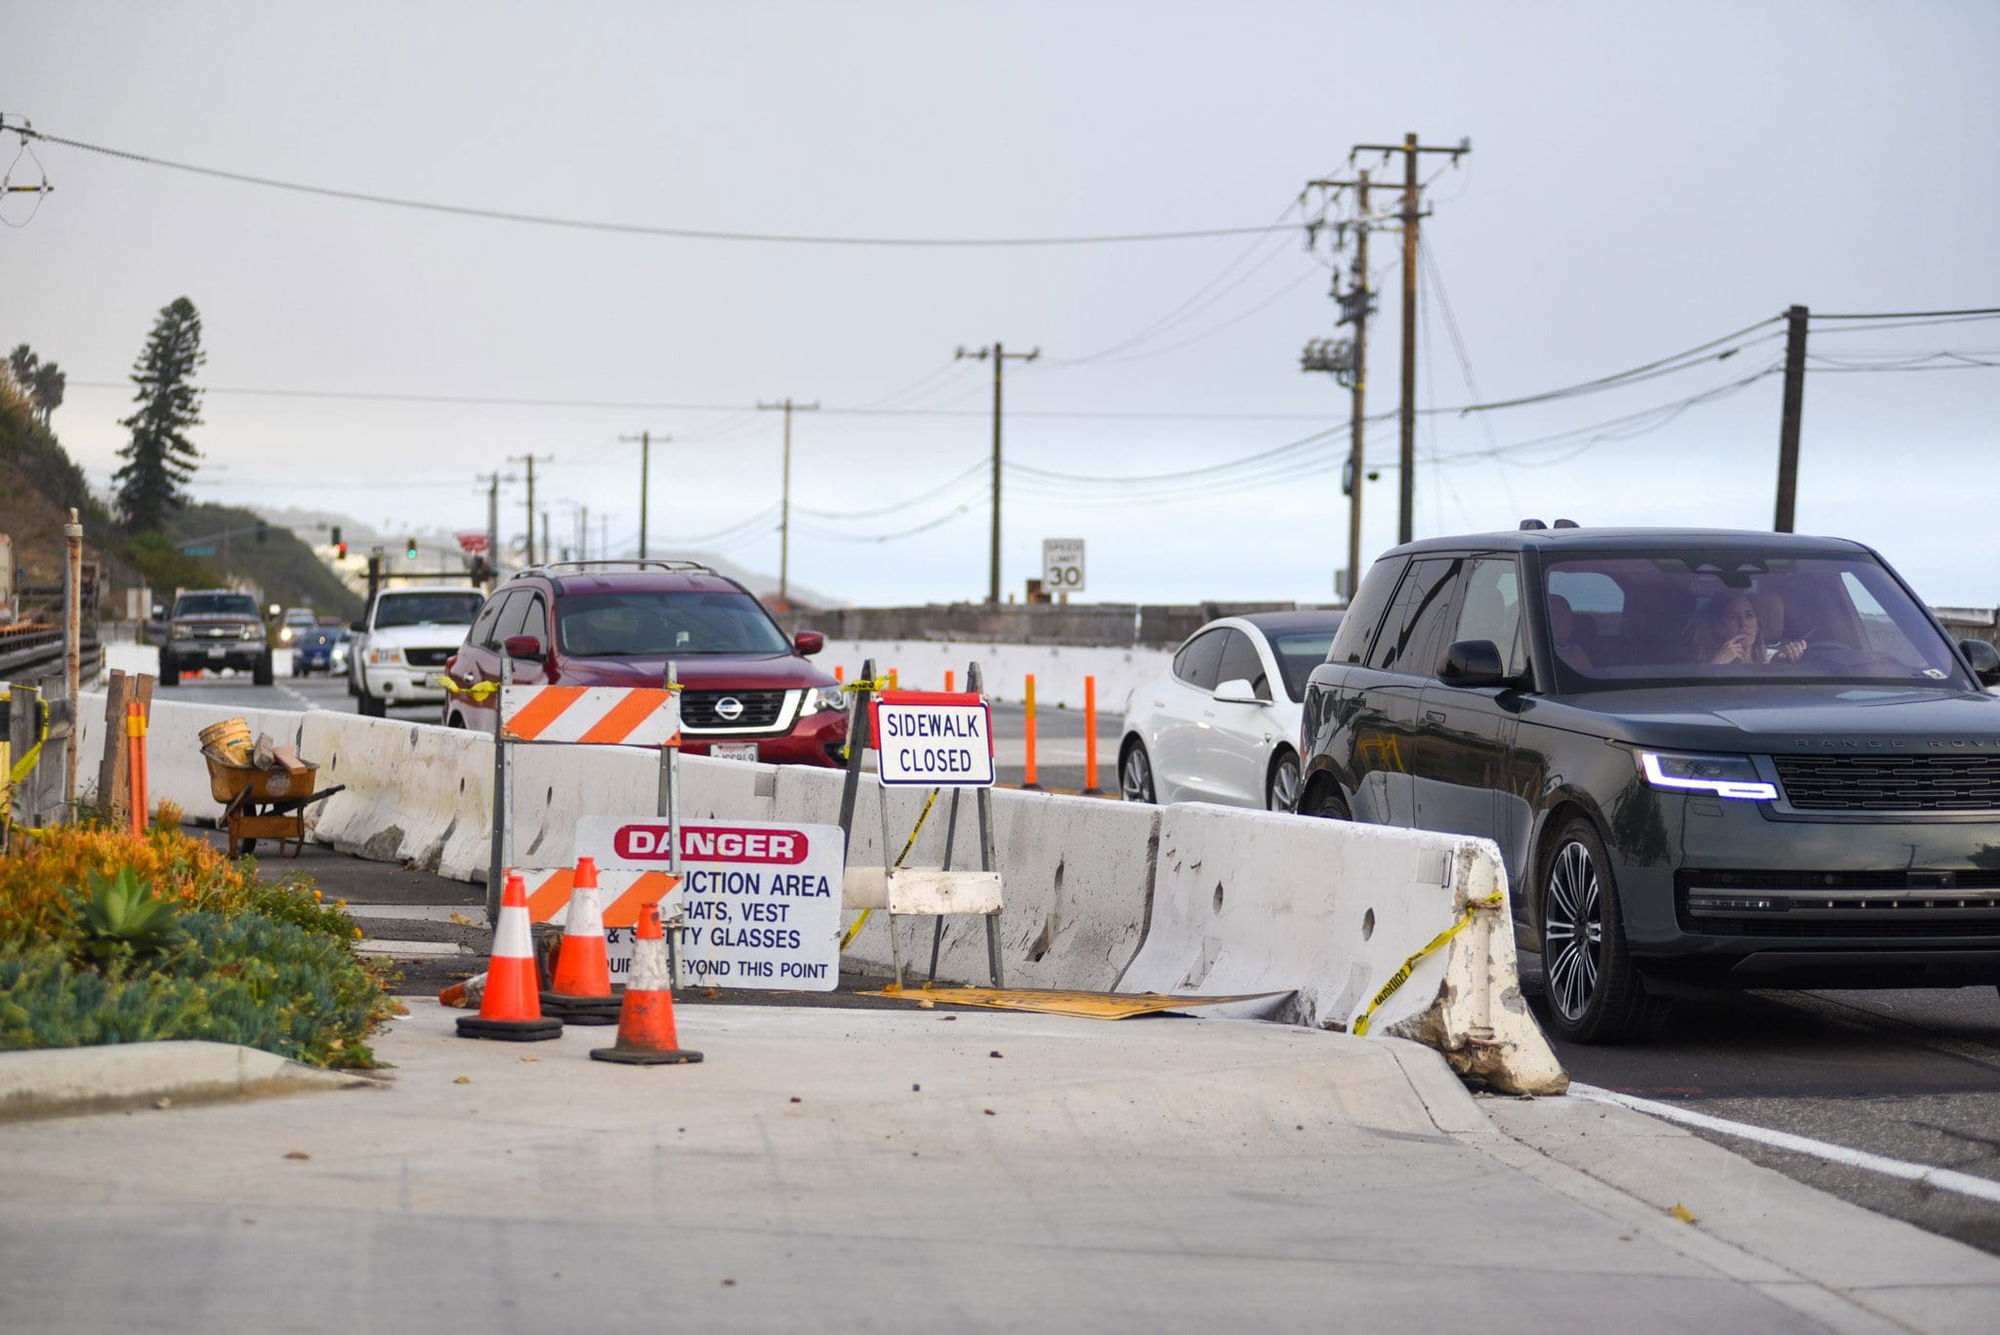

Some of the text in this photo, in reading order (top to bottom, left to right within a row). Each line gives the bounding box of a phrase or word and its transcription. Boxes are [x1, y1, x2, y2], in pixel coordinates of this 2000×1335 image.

[1050, 566, 1080, 586] 30
[887, 713, 979, 738] SIDEWALK
[1793, 738, 1904, 749] RANGE
[900, 748, 972, 772] CLOSED
[770, 873, 831, 898] AREA
[741, 902, 790, 922] VEST
[607, 928, 620, 944] &
[710, 927, 801, 949] GLASSES
[738, 961, 773, 977] THIS
[780, 962, 828, 979] POINT
